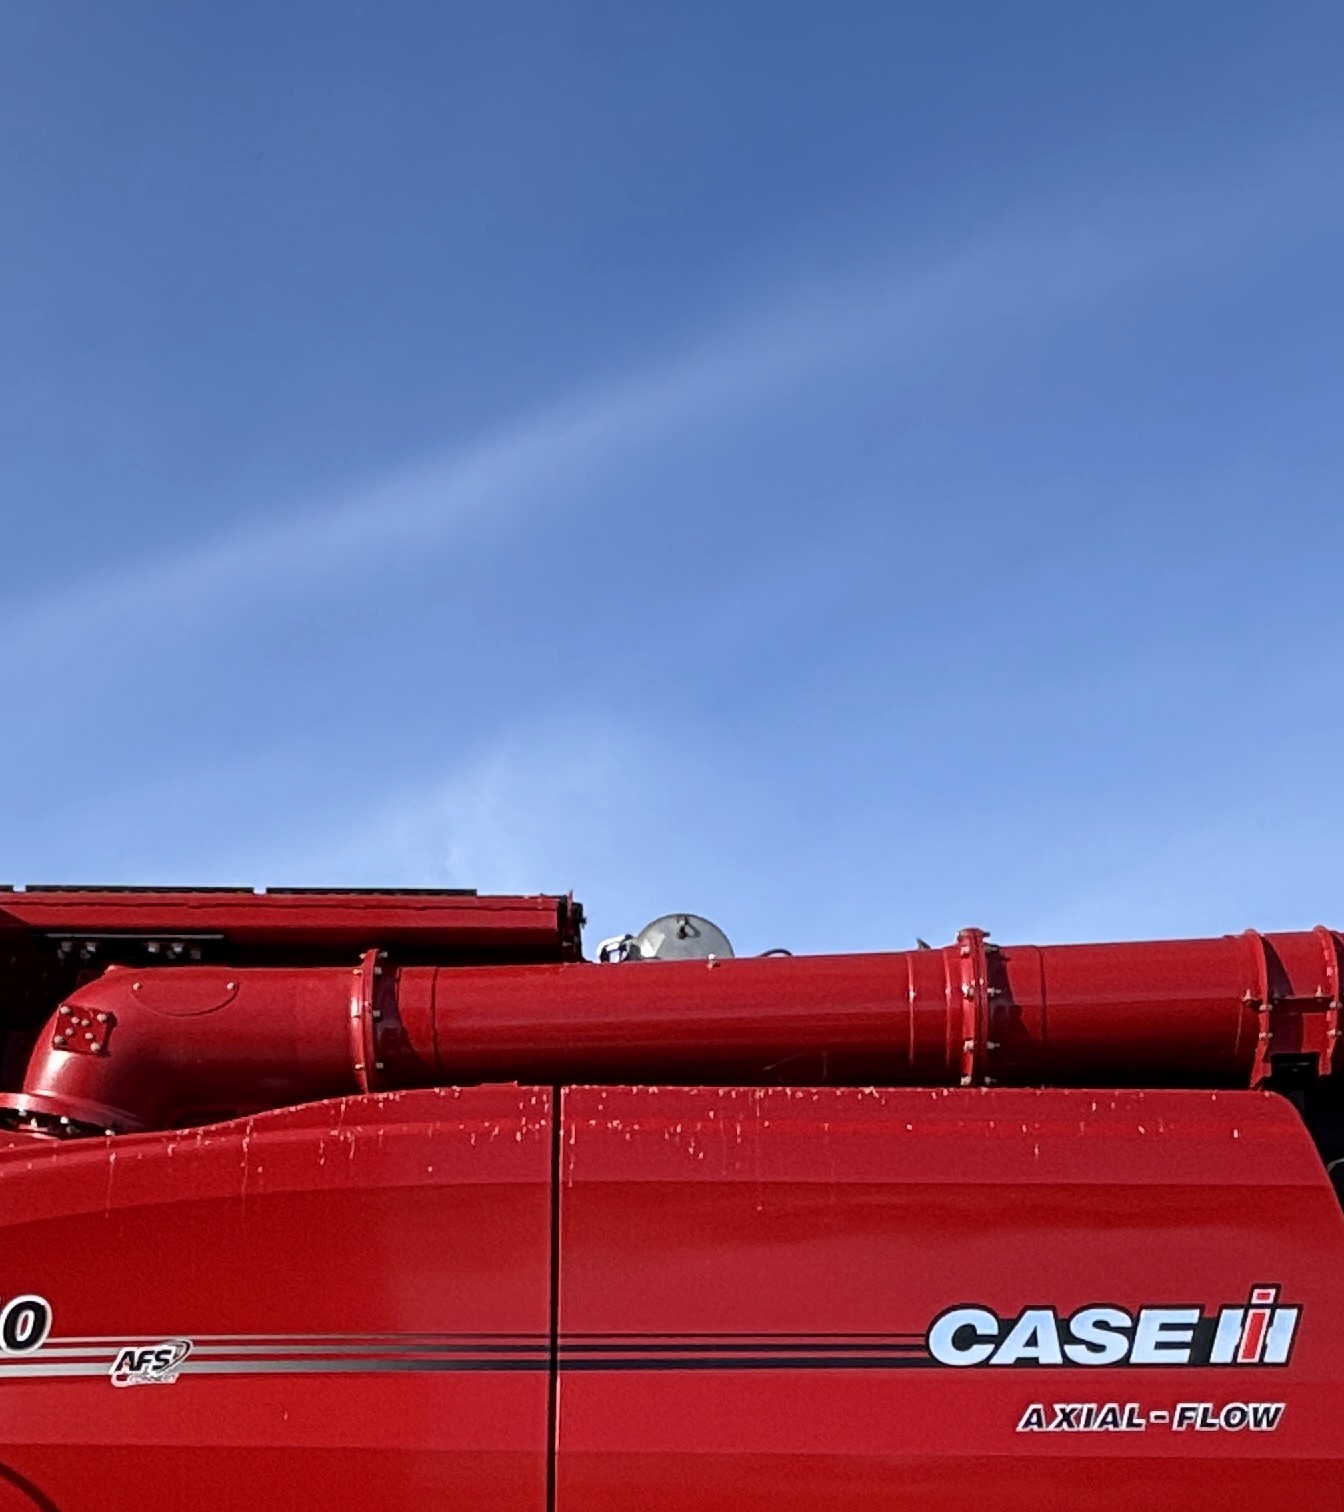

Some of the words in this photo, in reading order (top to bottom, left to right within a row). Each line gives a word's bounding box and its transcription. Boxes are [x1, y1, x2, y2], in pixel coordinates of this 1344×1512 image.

[929, 1305, 1199, 1366] CASE
[110, 1346, 176, 1373] AFS
[1016, 1402, 1286, 1431] AXIAL-FLOW
